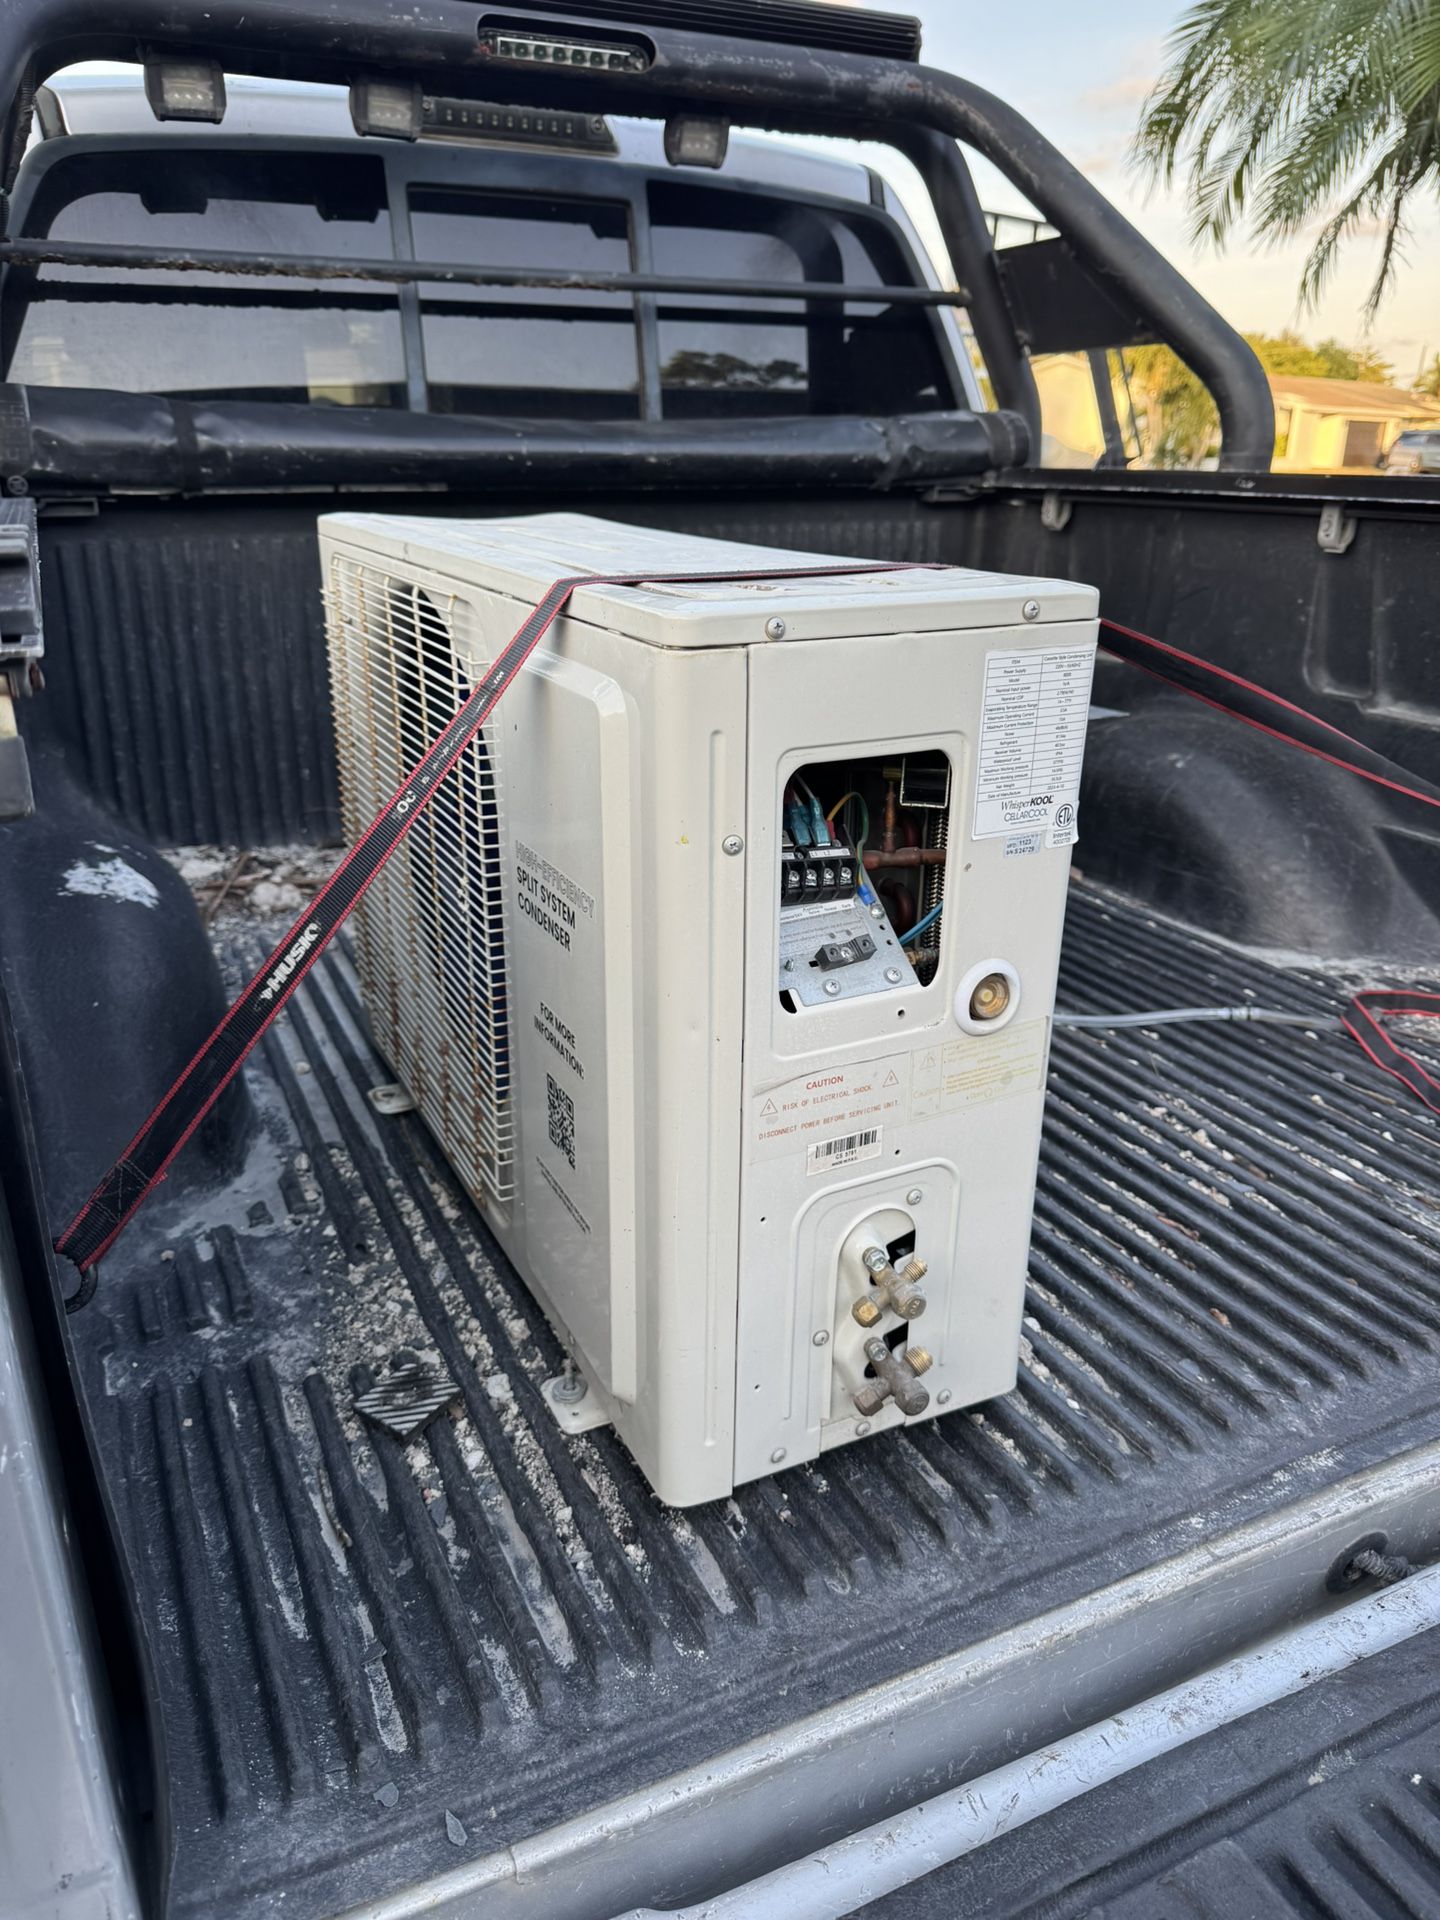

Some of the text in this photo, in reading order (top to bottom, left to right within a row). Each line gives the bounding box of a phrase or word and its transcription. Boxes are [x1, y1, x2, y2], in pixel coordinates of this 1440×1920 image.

[1001, 795, 1053, 812] WhisperKOOL
[516, 865, 576, 930] SPLIT SYSTEM
[517, 891, 571, 953] CONDENSER
[540, 1002, 577, 1050] FOR MORE
[782, 1101, 798, 1112] RISK
[801, 1099, 809, 1108] OF
[813, 1088, 850, 1105] ELECTRICAL
[806, 1073, 843, 1091] CAUTION
[758, 1125, 797, 1140] DISCONNECT
[801, 1119, 820, 1130] POWER
[823, 1113, 845, 1124] BEFORE
[849, 1104, 881, 1118] SERVICING
